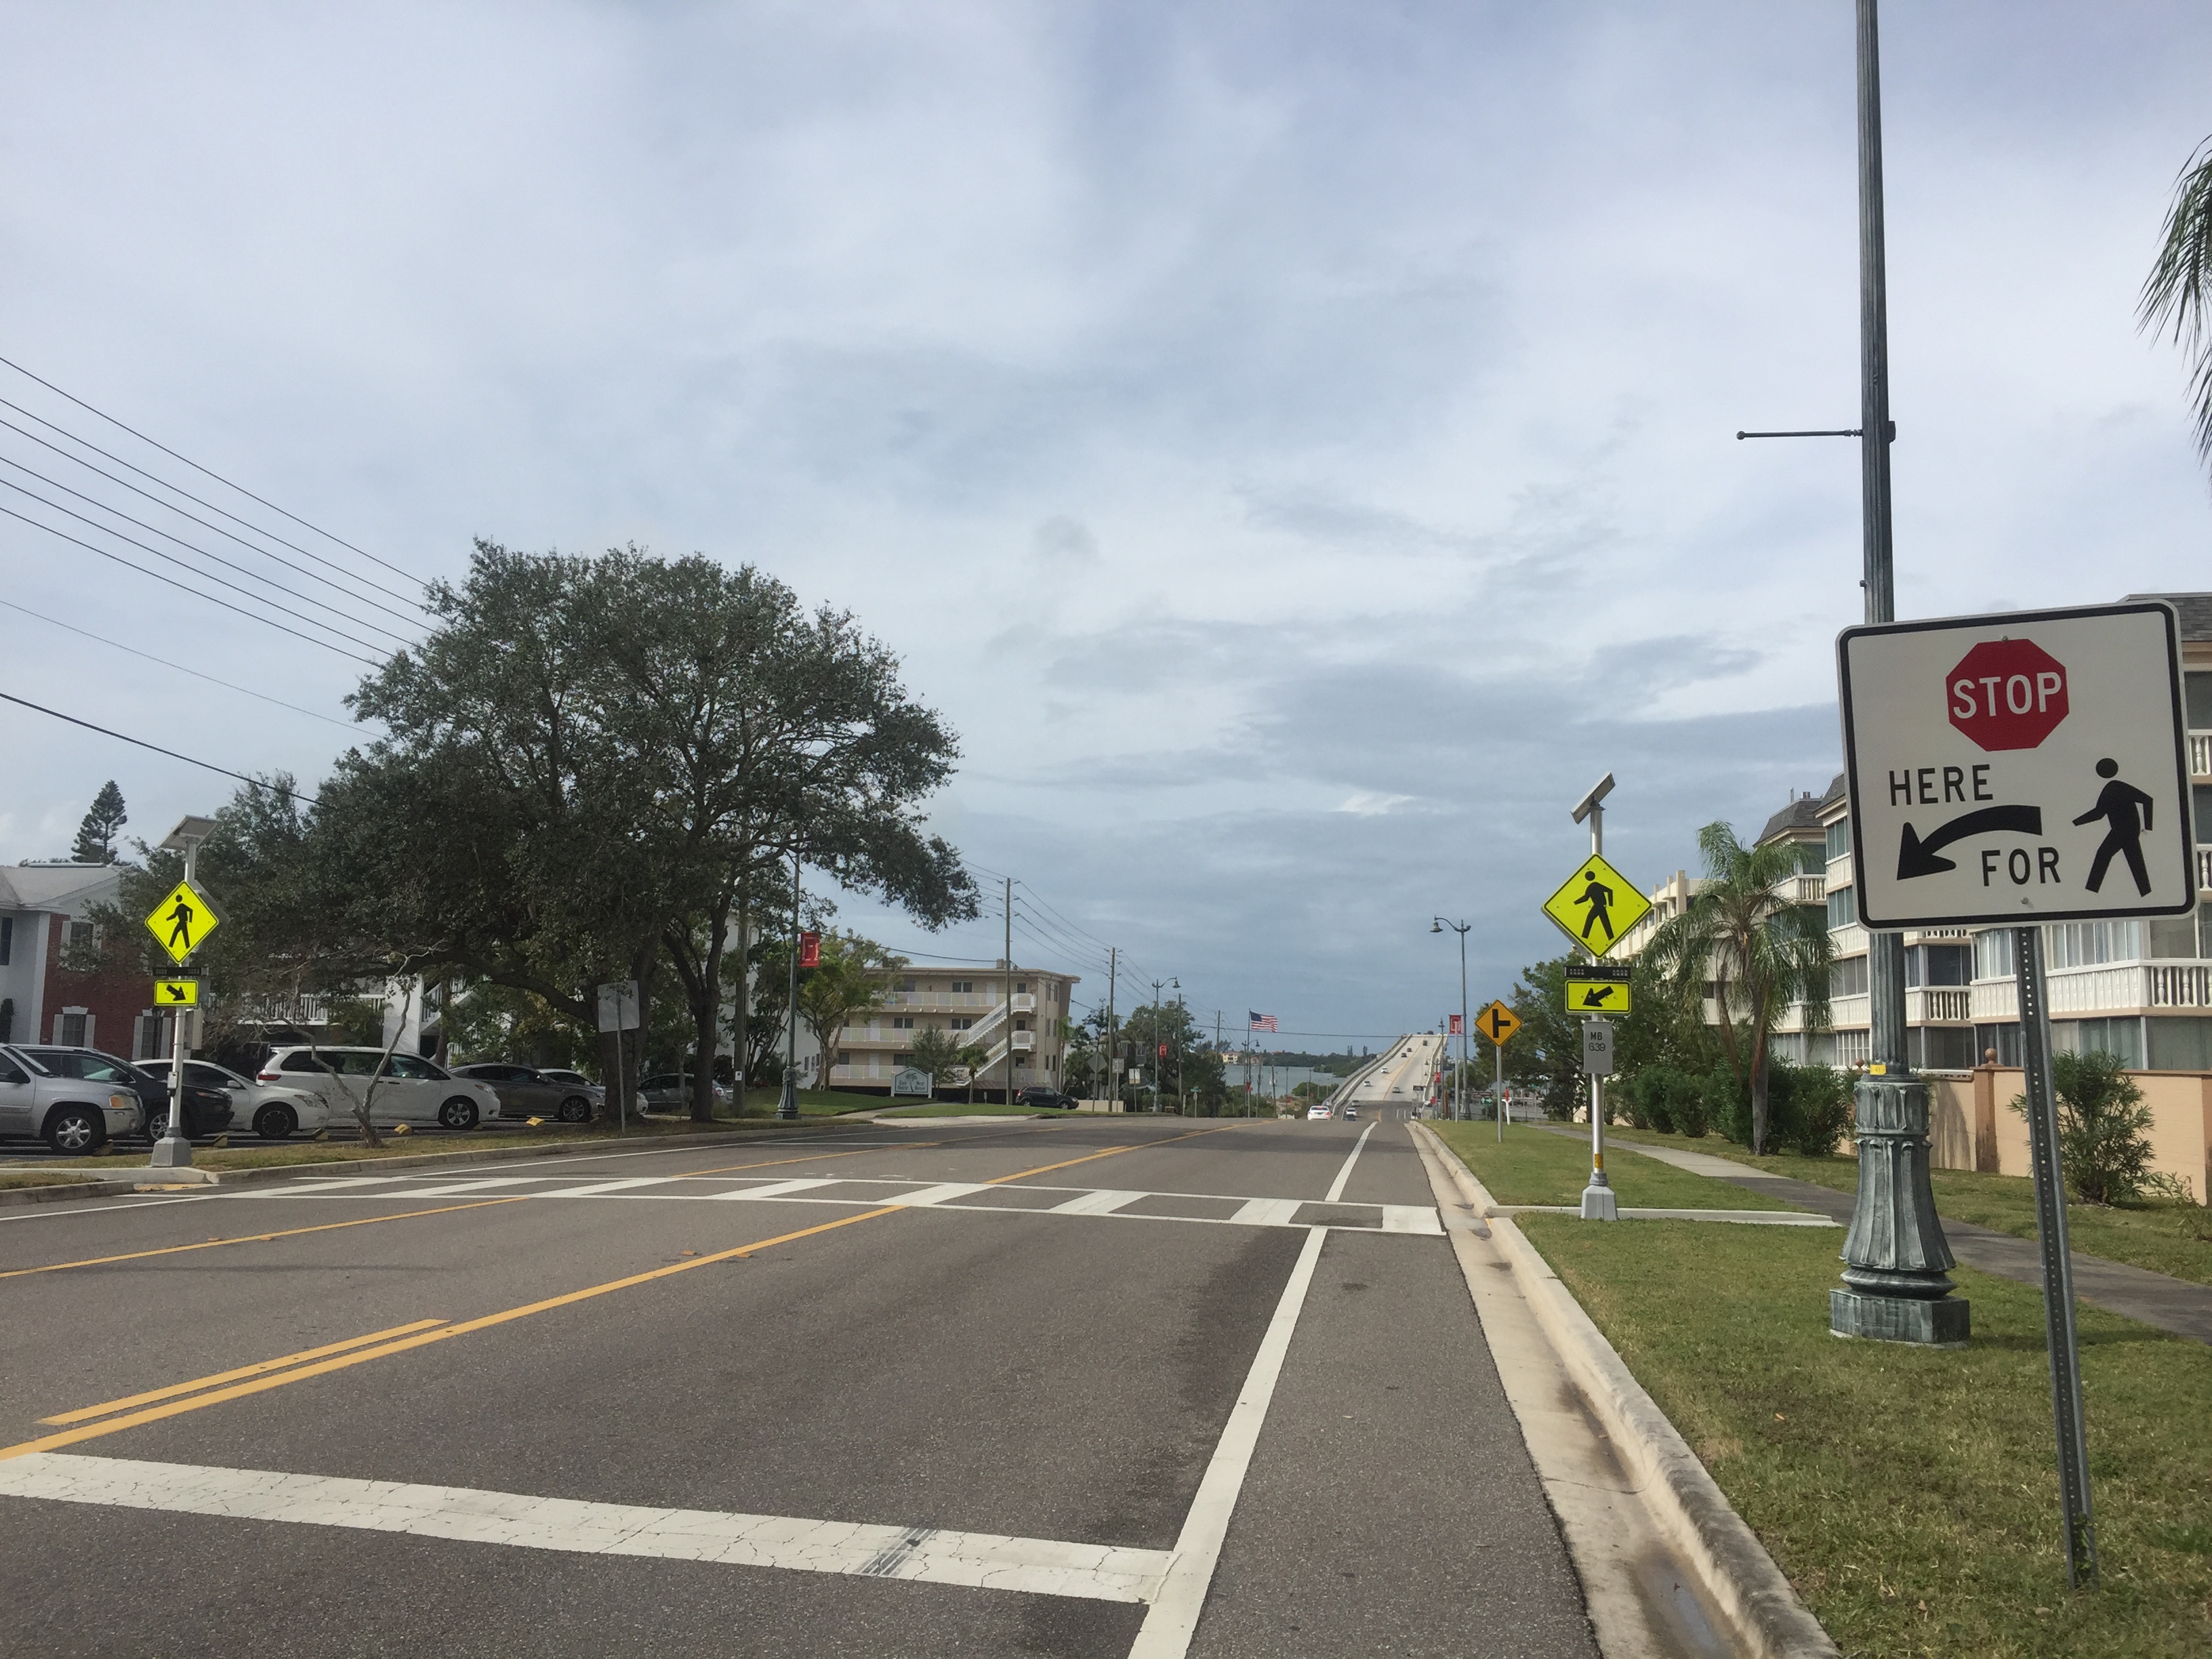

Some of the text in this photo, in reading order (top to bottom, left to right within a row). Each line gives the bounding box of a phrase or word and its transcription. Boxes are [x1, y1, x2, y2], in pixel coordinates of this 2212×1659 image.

[1952, 672, 2062, 719] STOP
[1889, 764, 1994, 806] HERE
[1981, 847, 2061, 887] FOR
[1589, 1042, 1605, 1051] 639
[1590, 1031, 1602, 1040] MB
